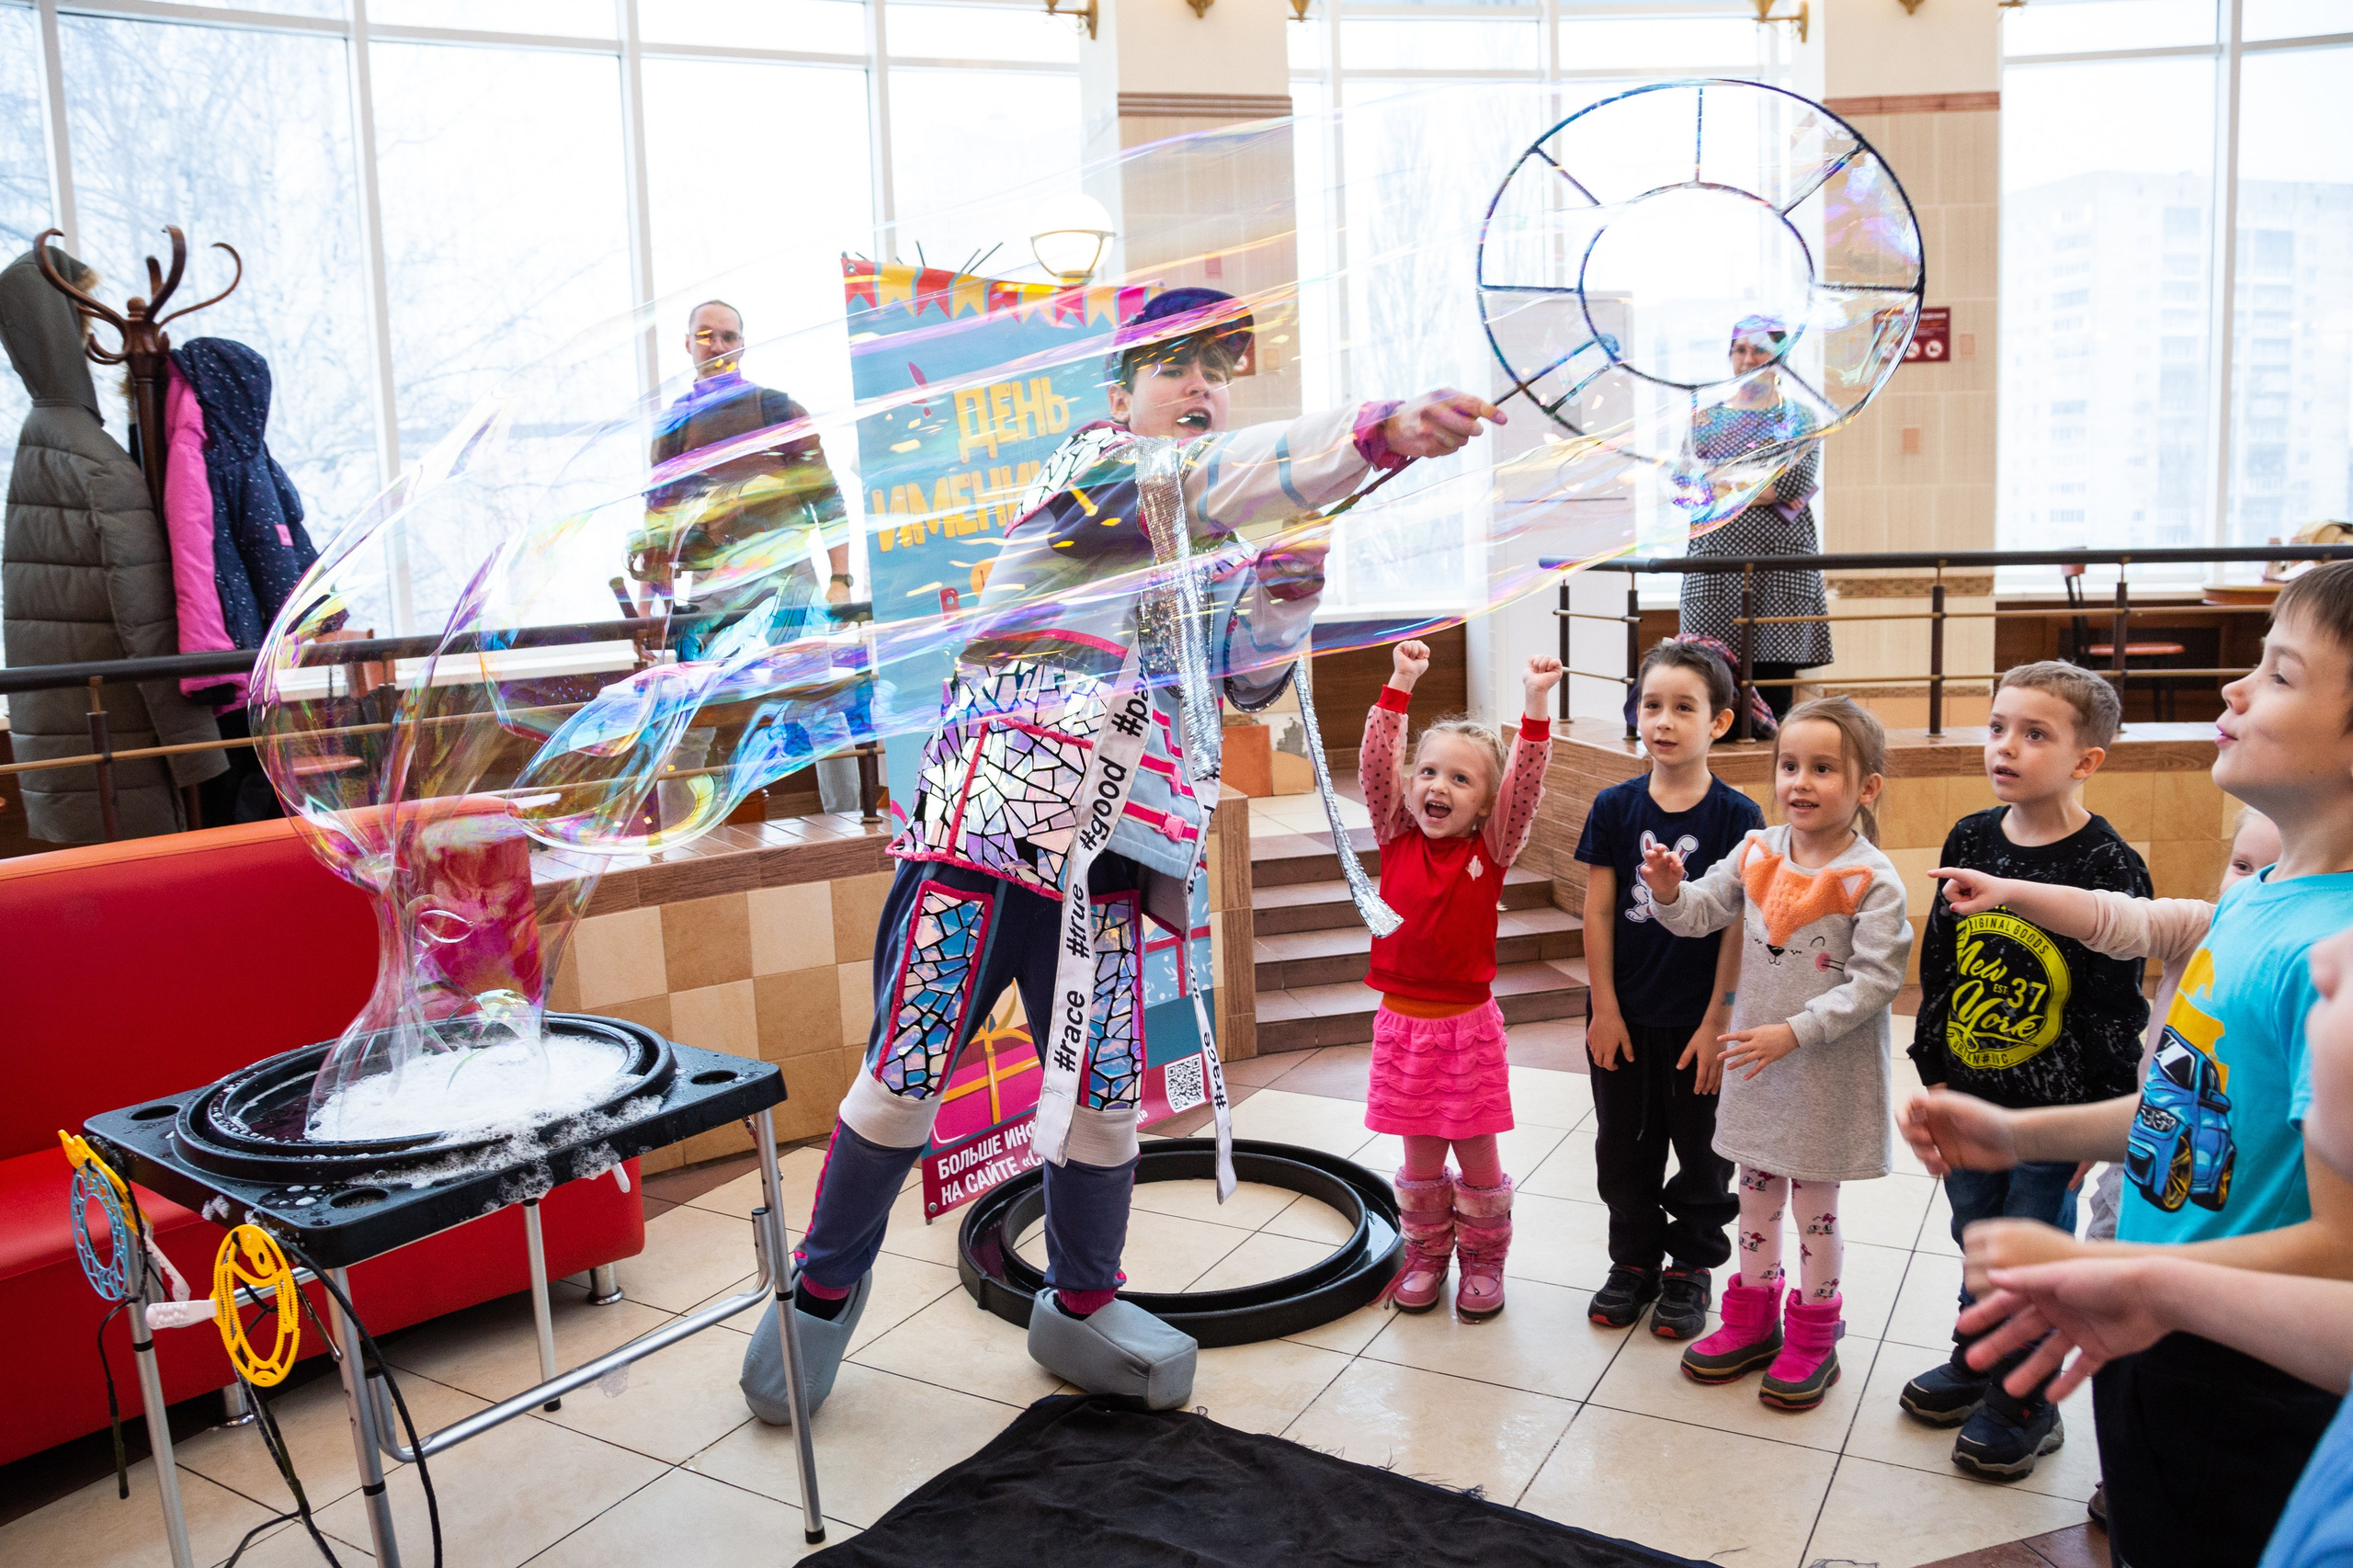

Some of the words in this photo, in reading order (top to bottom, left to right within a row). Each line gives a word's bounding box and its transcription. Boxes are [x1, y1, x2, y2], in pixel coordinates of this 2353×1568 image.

[953, 377, 1070, 463] ДЕНЬ
[871, 460, 1040, 552] ИМЕНИ
[1079, 755, 1128, 851] #good
[1065, 882, 1090, 959] #true
[2013, 925, 2050, 954] GOODS
[1958, 939, 2008, 982] New
[2006, 977, 2048, 1013] 37
[1053, 990, 1086, 1073] #race
[1951, 979, 2045, 1051] York
[1203, 1031, 1226, 1110] #race
[938, 1134, 1003, 1180] БОЛЬШЕ
[941, 1181, 965, 1206] НА
[965, 1155, 1021, 1193] САЙТЕ
